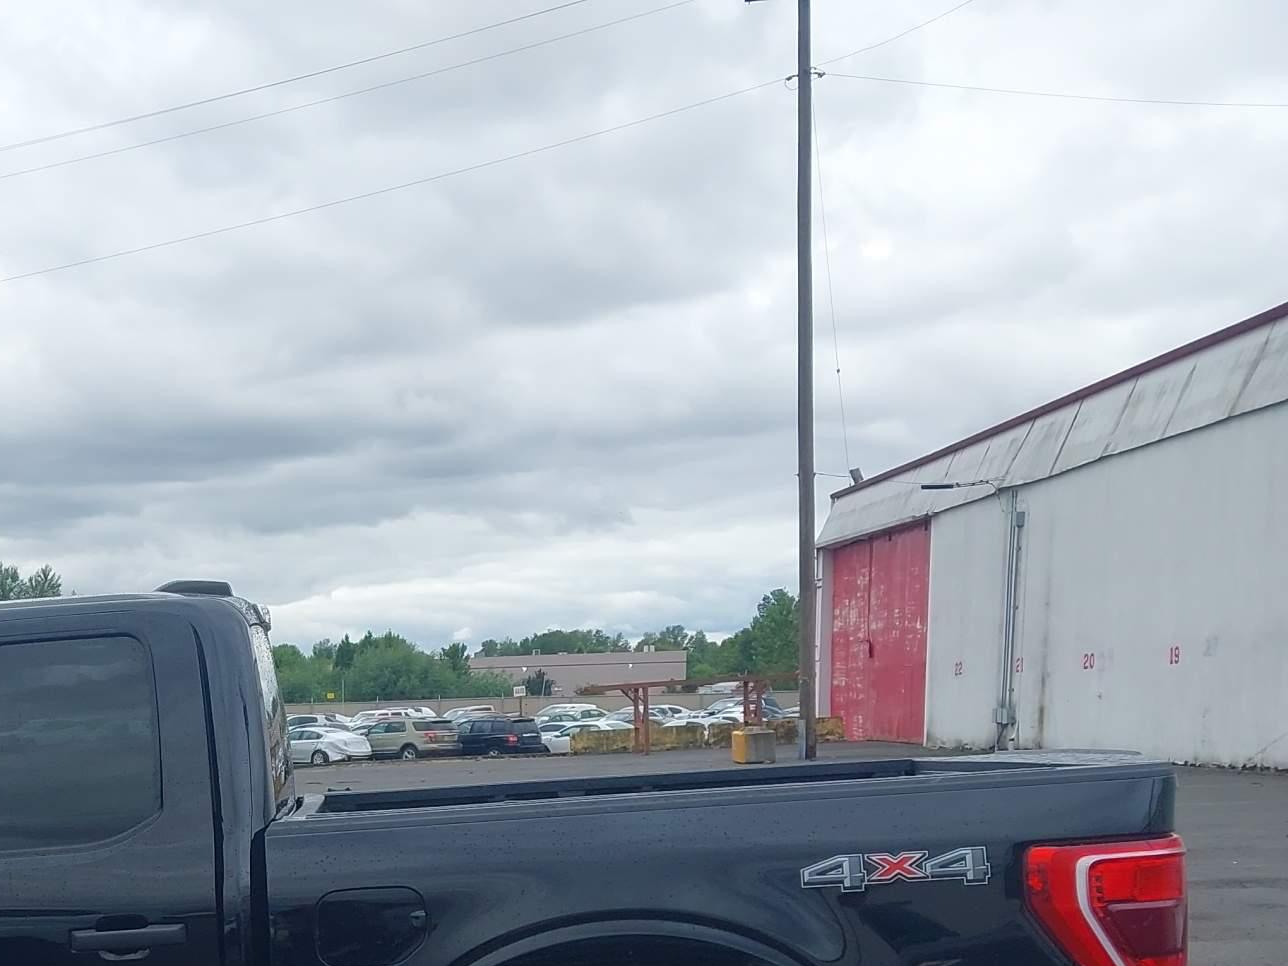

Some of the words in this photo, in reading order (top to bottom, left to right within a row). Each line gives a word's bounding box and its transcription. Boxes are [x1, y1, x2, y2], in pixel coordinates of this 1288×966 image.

[1082, 652, 1095, 670] 20
[1169, 646, 1180, 665] 19
[954, 661, 963, 676] 22
